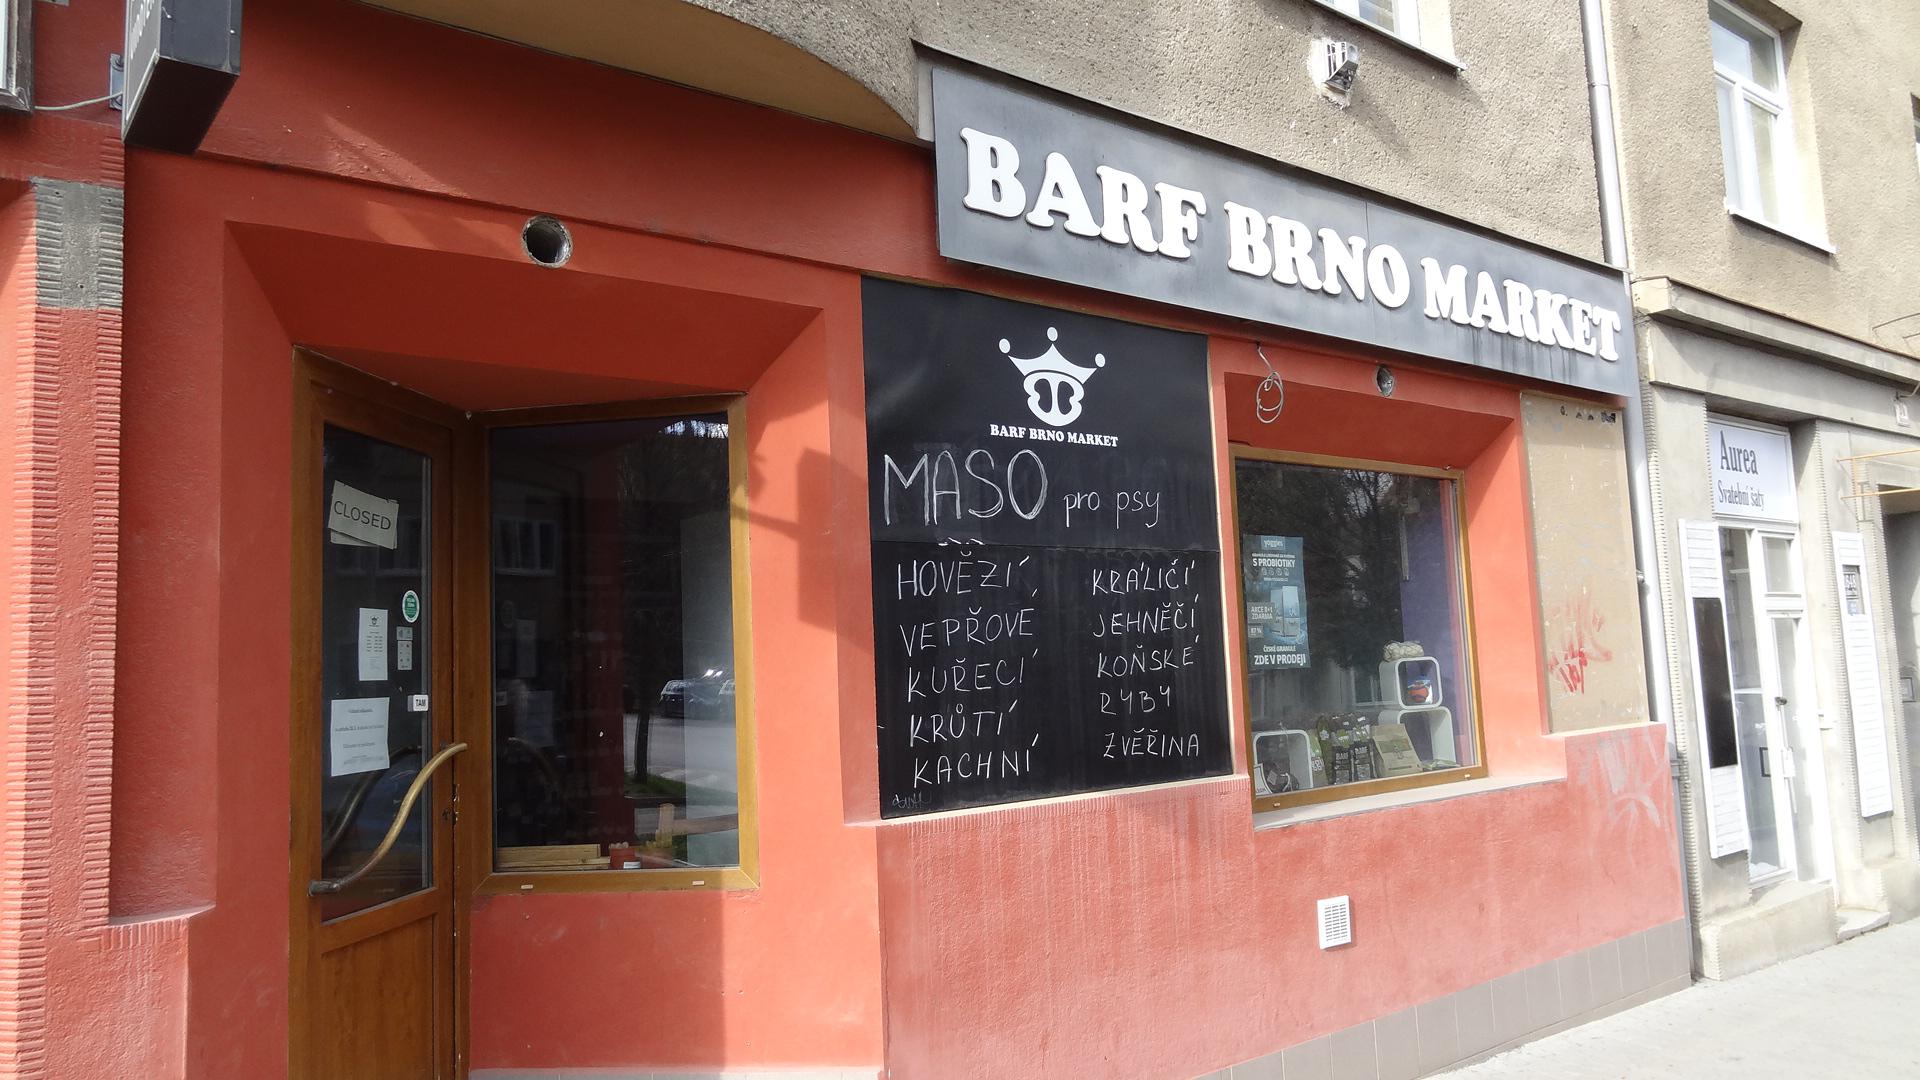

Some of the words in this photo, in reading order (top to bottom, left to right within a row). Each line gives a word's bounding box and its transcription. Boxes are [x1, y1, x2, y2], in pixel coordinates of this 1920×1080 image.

[960, 127, 1207, 259] BARF
[1224, 201, 1410, 308] BRNO
[1420, 257, 1621, 362] MARKET
[990, 424, 1026, 438] BARF
[1029, 427, 1065, 442] BRNO
[1067, 431, 1118, 447] MARKET
[1720, 430, 1758, 475] Aurea
[884, 449, 1048, 526] MASO
[1063, 490, 1100, 527] pro
[1116, 490, 1160, 528] psy
[1718, 479, 1749, 506] Svatební
[333, 501, 391, 530] CLOSED
[897, 550, 1029, 600] HOVĚZÍ
[1092, 558, 1195, 596] KRÁLIČÍ
[1252, 558, 1258, 567] S
[1258, 558, 1296, 568] PROBIOTIKY
[900, 588, 1038, 657] VEPŘOVÉ
[1093, 593, 1199, 638] JEHNĚČÍ
[908, 648, 1038, 702] KUŘECÍ
[1097, 634, 1199, 678] KOŇSKÉ
[1254, 654, 1269, 666] ZDE
[1269, 654, 1276, 665] V
[1276, 653, 1306, 666] PRODEJI
[1100, 685, 1171, 715] RYBY
[910, 699, 1018, 747] KRŮTÍ
[1103, 727, 1199, 758] ZVĚŘINA
[914, 733, 1039, 788] KACHNÍ
